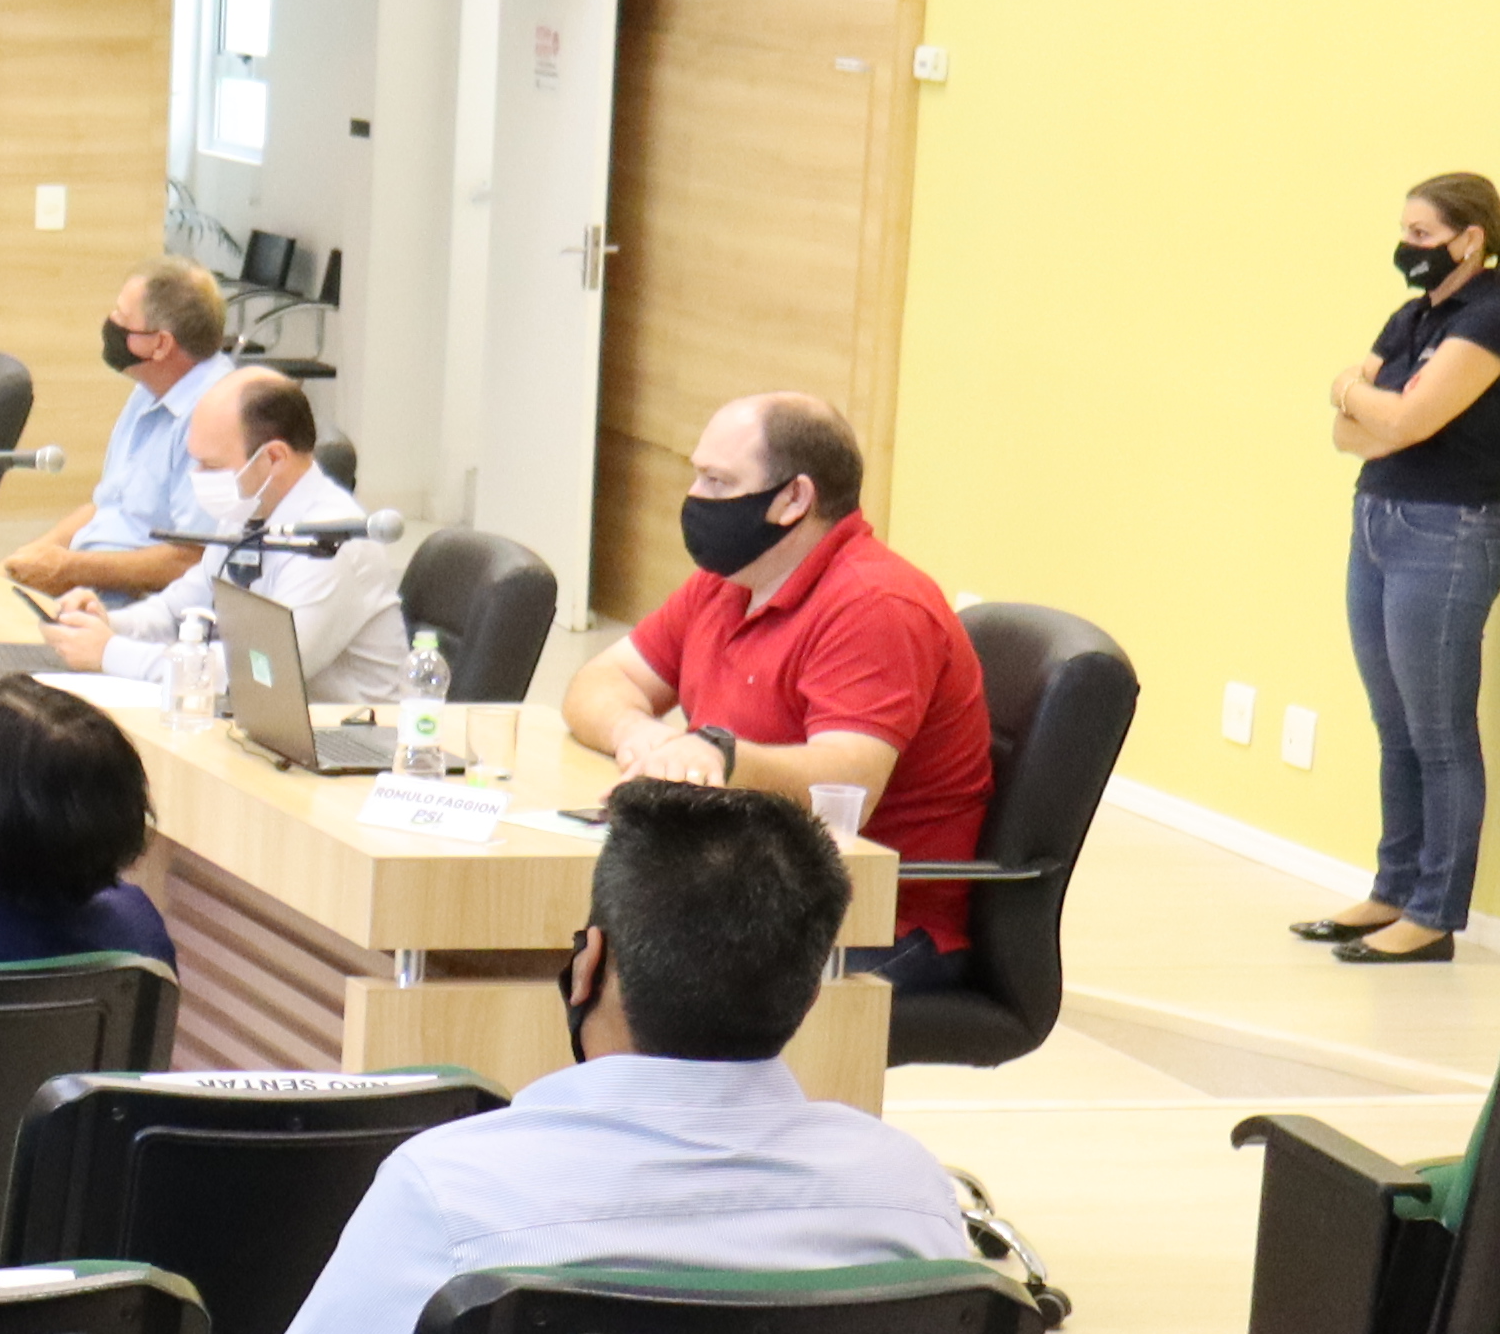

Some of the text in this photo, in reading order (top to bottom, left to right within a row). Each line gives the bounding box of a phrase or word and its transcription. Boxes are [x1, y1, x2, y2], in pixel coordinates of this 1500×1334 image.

[374, 787, 500, 816] ROMULO FAGGION
[411, 809, 445, 824] PSL
